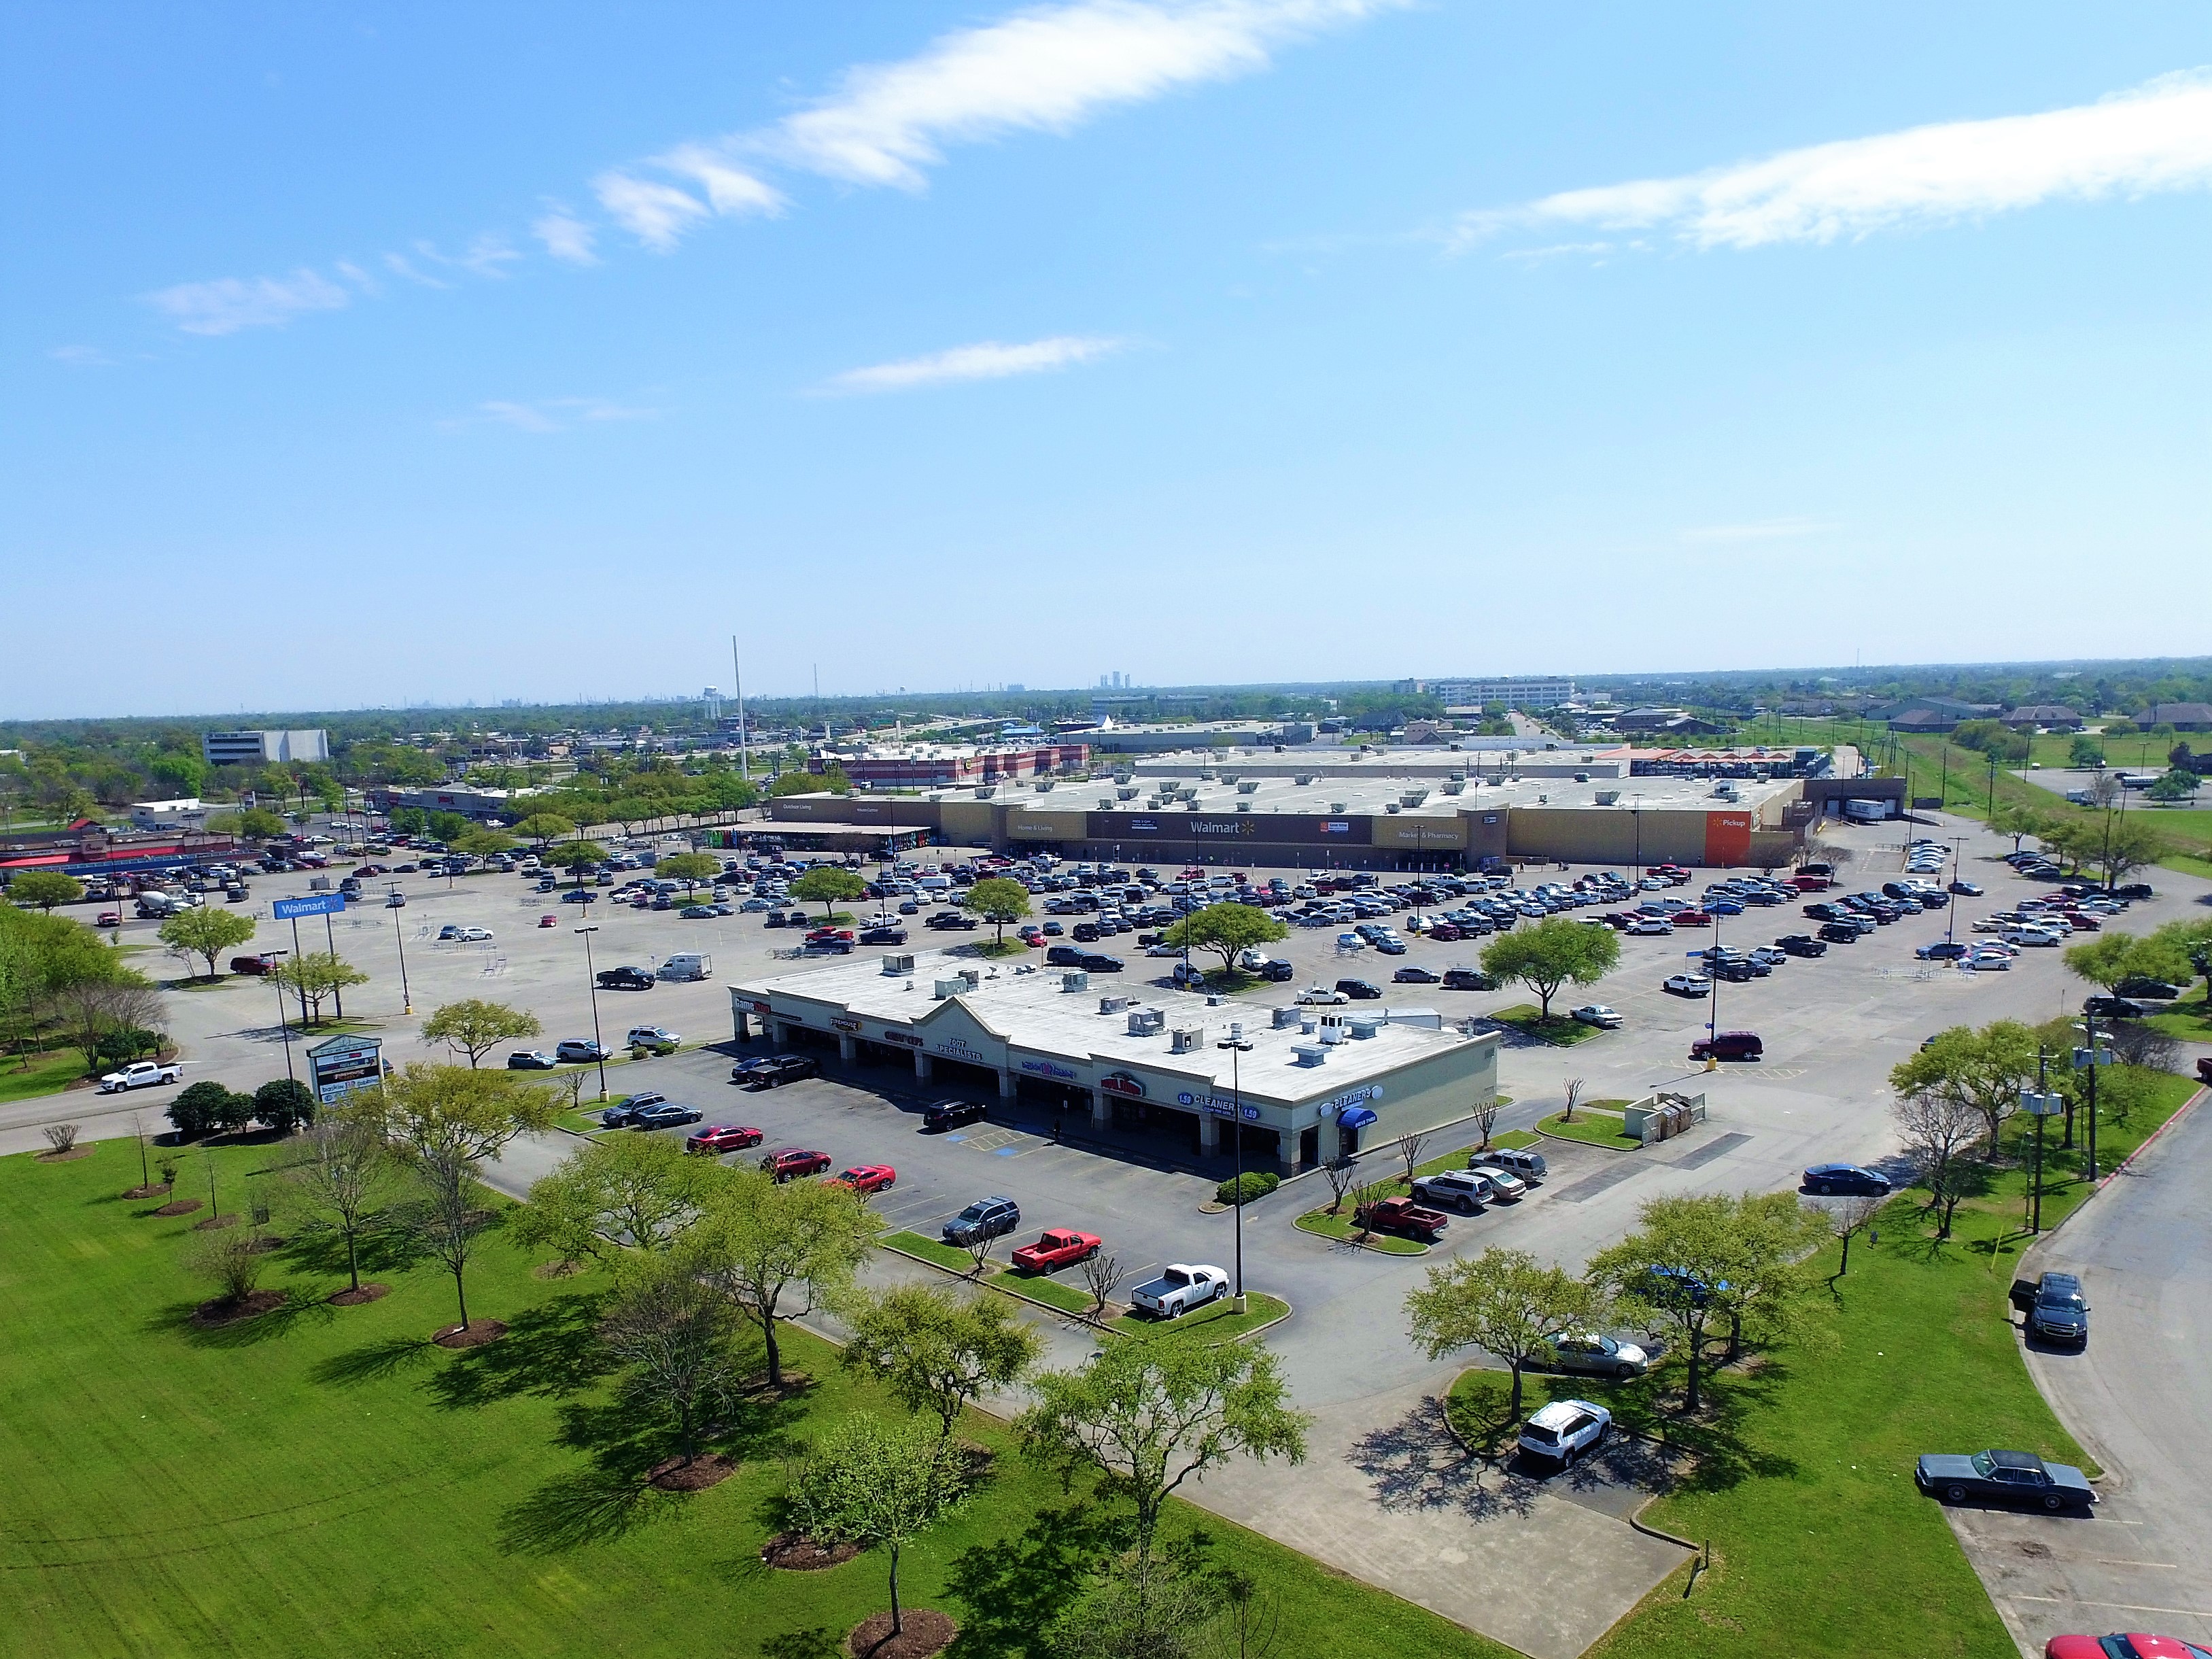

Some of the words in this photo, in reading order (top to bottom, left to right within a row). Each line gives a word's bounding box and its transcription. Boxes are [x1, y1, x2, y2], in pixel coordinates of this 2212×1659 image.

[1191, 821, 1240, 834] Walmart
[1723, 819, 1746, 828] Pickup
[1428, 832, 1459, 840] Pharmacy
[281, 900, 326, 914] Walmart
[949, 1038, 965, 1048] FOOT
[935, 1045, 982, 1060] SPECIALISTS
[1334, 1088, 1372, 1109] CLEANERS
[1179, 1095, 1192, 1104] 1.59
[1194, 1095, 1241, 1112] CLEANERS
[1244, 1108, 1257, 1118] 1.59
